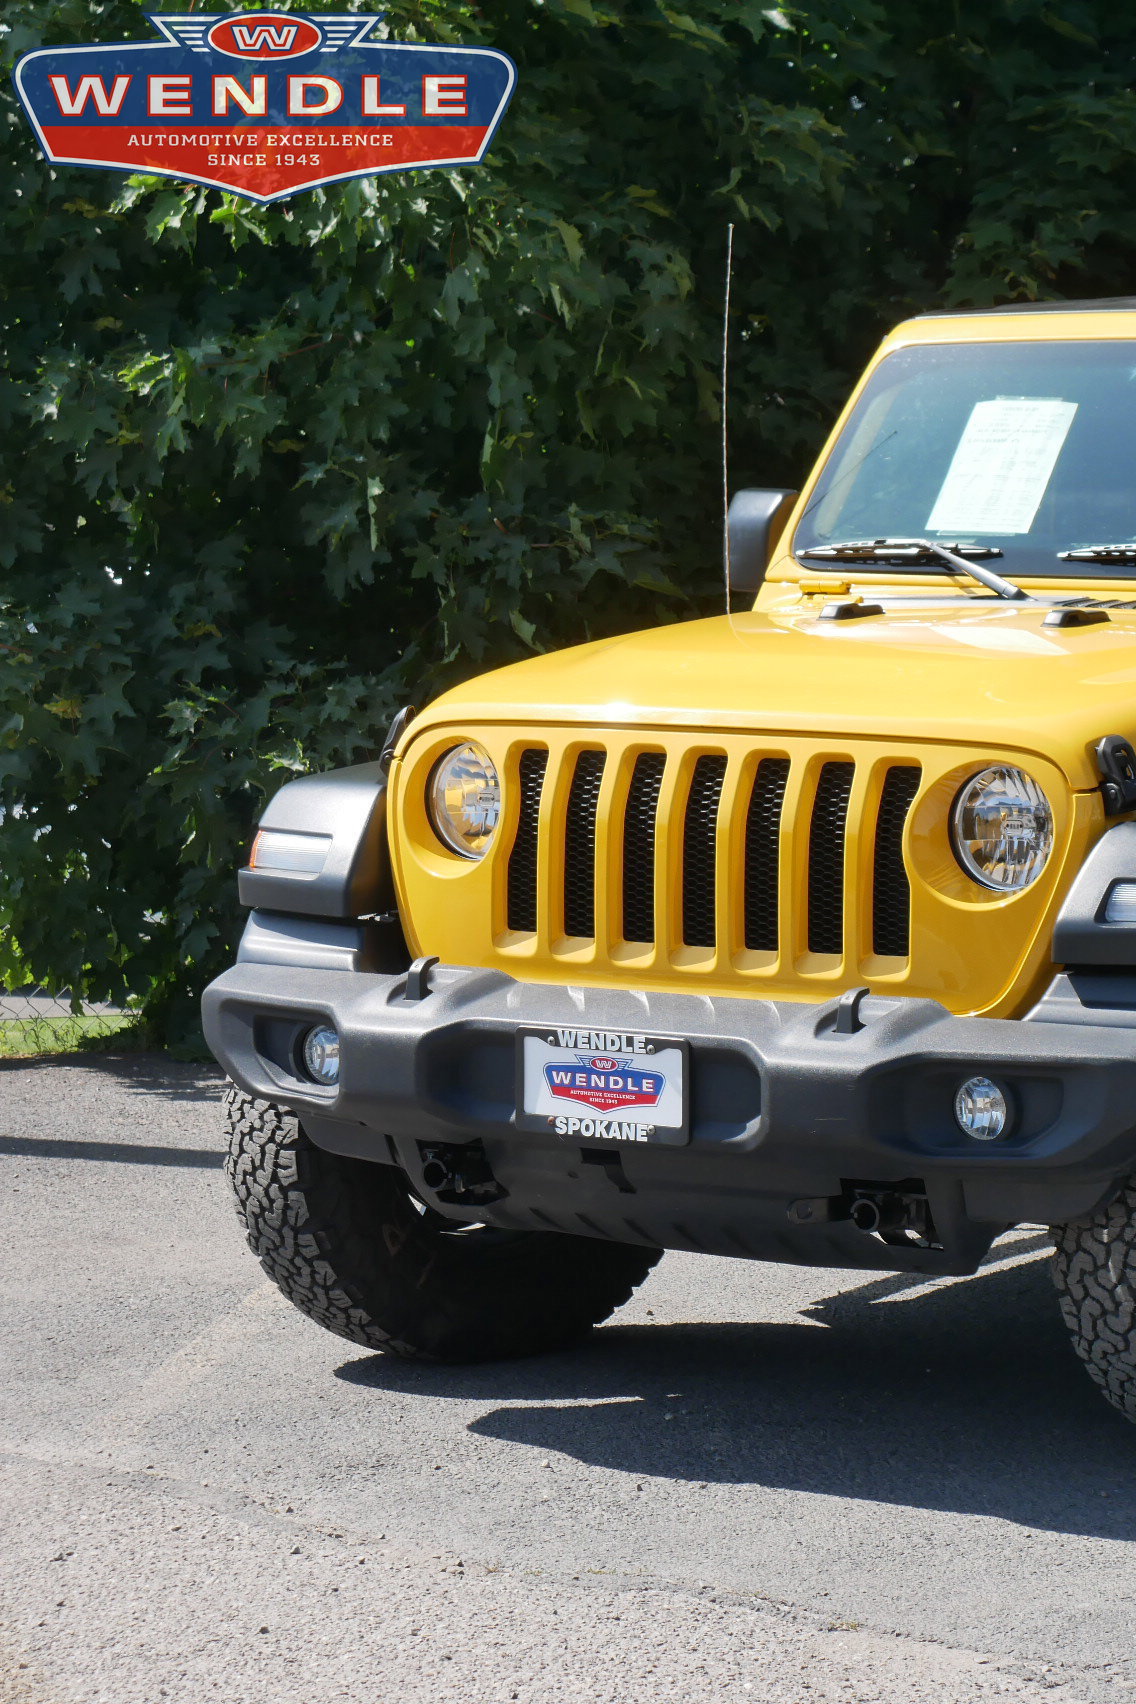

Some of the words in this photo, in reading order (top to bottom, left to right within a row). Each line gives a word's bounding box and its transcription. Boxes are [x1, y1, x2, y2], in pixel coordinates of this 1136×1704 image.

[556, 1030, 647, 1054] WENDLE
[552, 1071, 654, 1092] WENDLE
[603, 1092, 636, 1100] EXCELLENCE
[555, 1116, 648, 1142] SPOKANE
